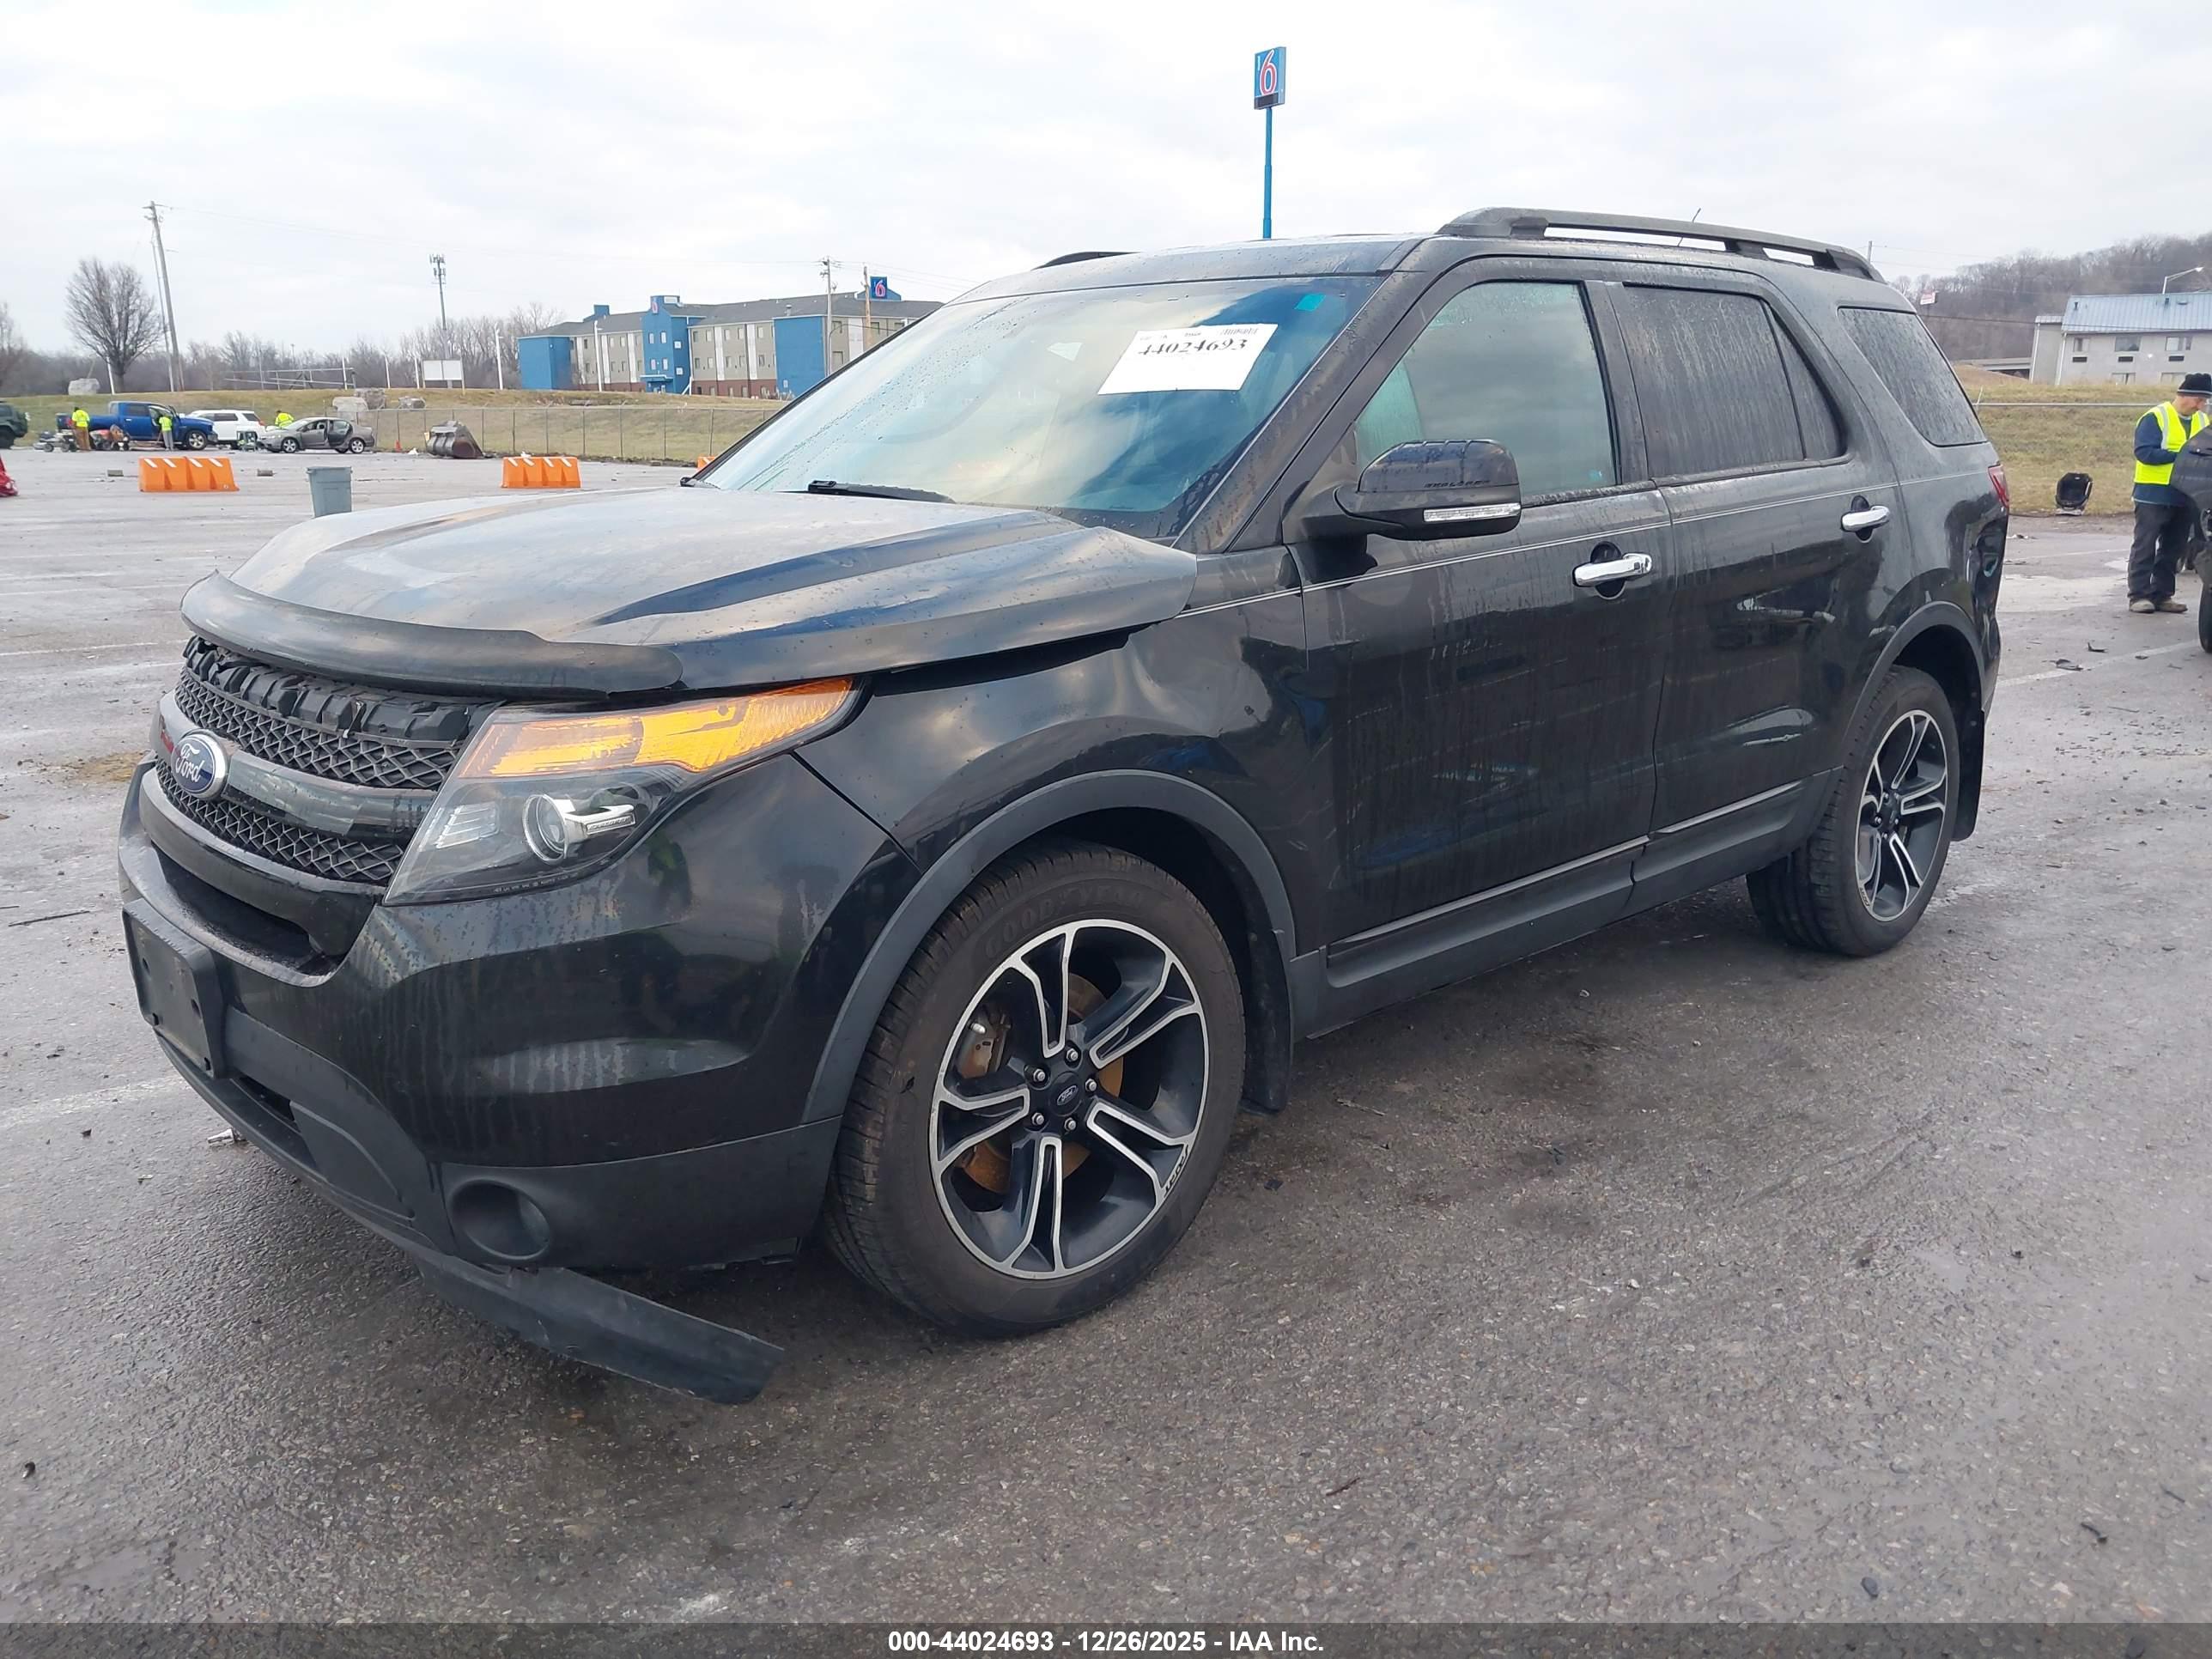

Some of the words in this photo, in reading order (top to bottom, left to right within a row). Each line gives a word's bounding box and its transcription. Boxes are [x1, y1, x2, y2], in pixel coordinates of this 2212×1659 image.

[1260, 49, 1278, 96] 6
[875, 280, 886, 297] 6
[1138, 338, 1248, 355] 44024693
[175, 744, 205, 782] Ford
